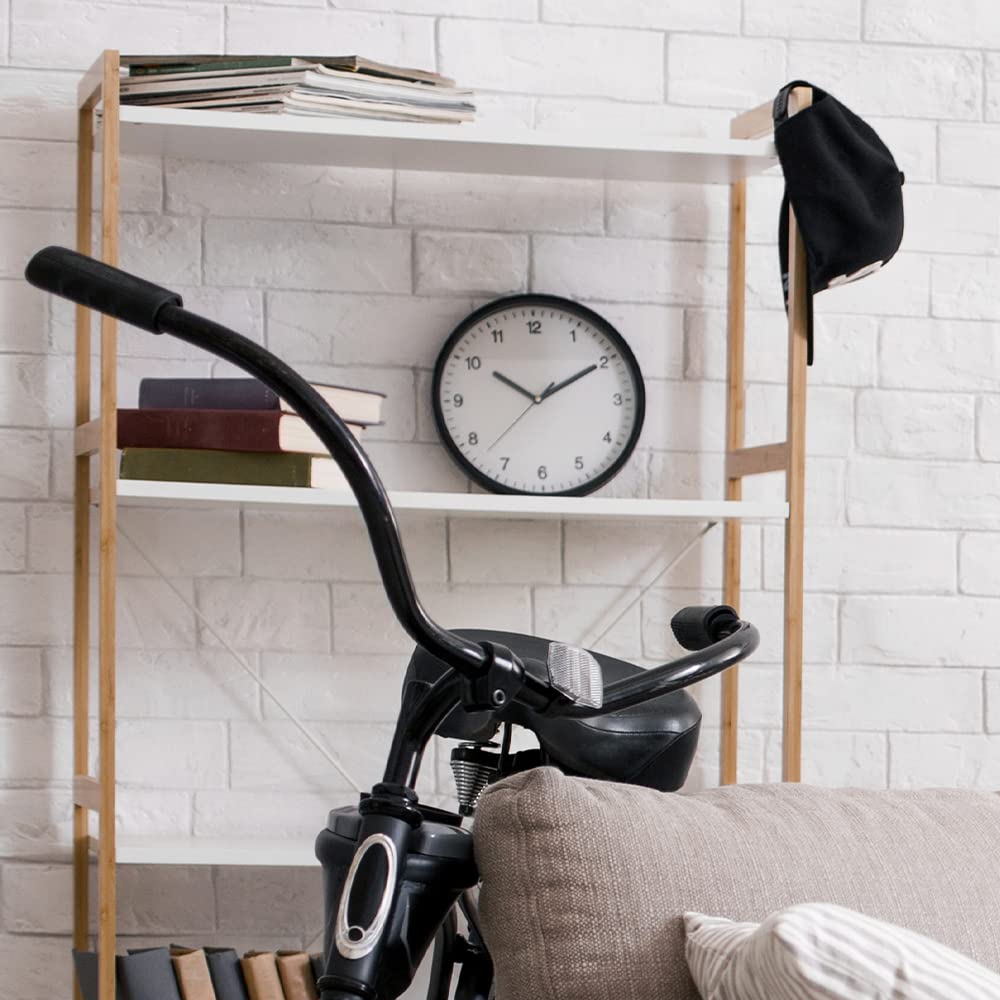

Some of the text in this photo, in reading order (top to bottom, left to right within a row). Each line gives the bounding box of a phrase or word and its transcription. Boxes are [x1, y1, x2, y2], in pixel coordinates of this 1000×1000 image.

[526, 320, 542, 335] 12
[491, 329, 504, 343] 11
[569, 330, 577, 343] 1
[465, 356, 482, 370] 10
[599, 356, 609, 369] 2
[453, 393, 464, 408] 9
[613, 393, 623, 406] 3
[468, 431, 479, 446] 8
[602, 431, 612, 444] 4
[500, 457, 510, 471] 7
[574, 456, 584, 470] 5
[537, 465, 548, 480] 6
